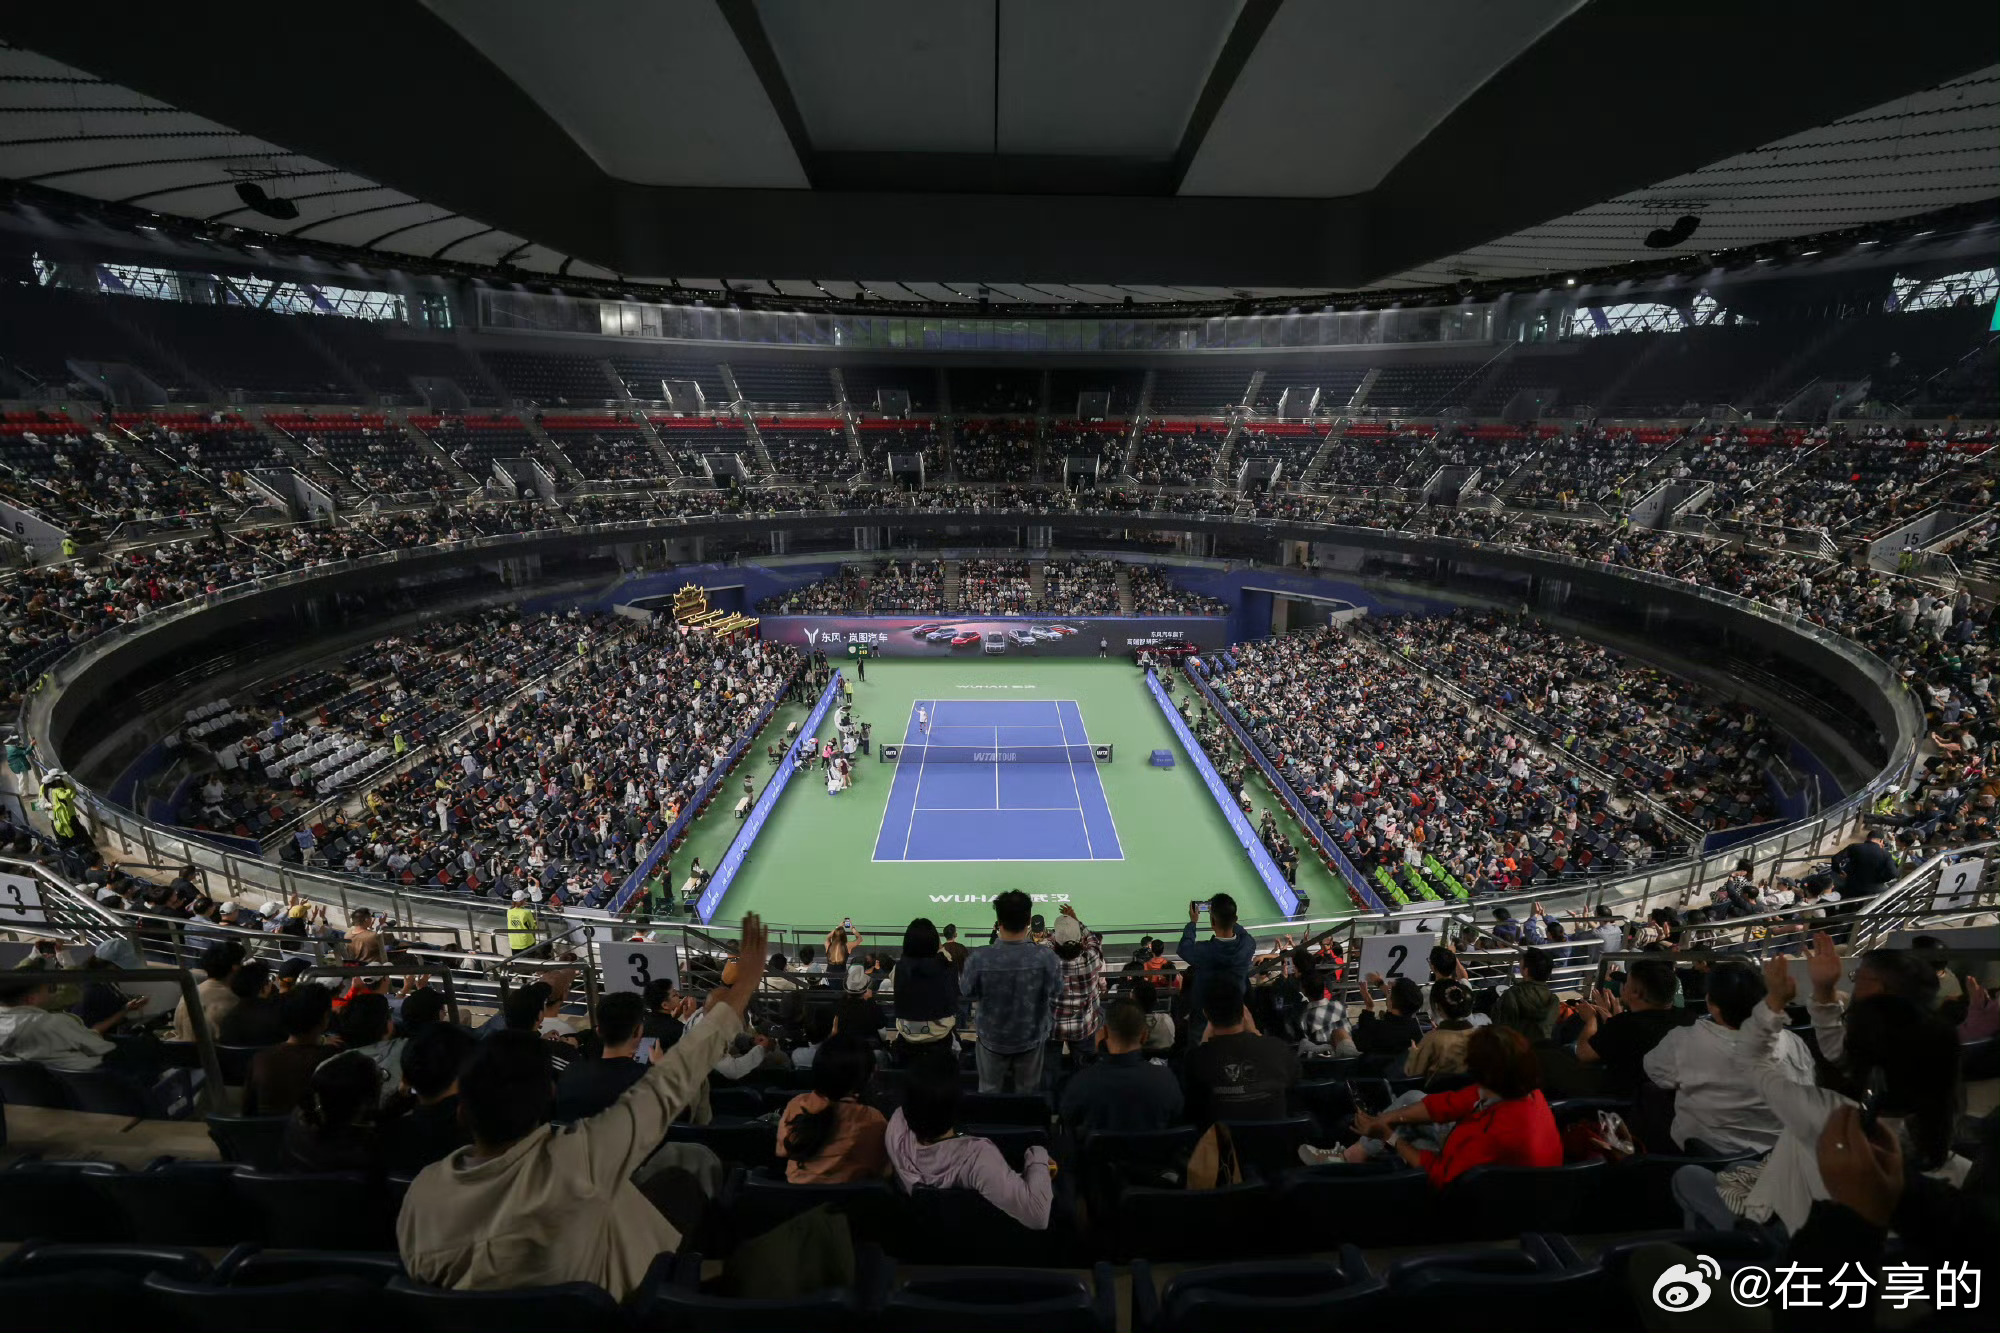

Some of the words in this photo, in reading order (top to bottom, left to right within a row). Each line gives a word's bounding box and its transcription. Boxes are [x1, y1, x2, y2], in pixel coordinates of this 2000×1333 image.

[1648, 502, 1658, 511] 14
[15, 521, 25, 534] 6
[1903, 533, 1920, 545] 15
[998, 752, 1017, 762] TOUR
[1948, 872, 1967, 902] 2
[1385, 944, 1408, 978] 2
[628, 953, 650, 987] 3
